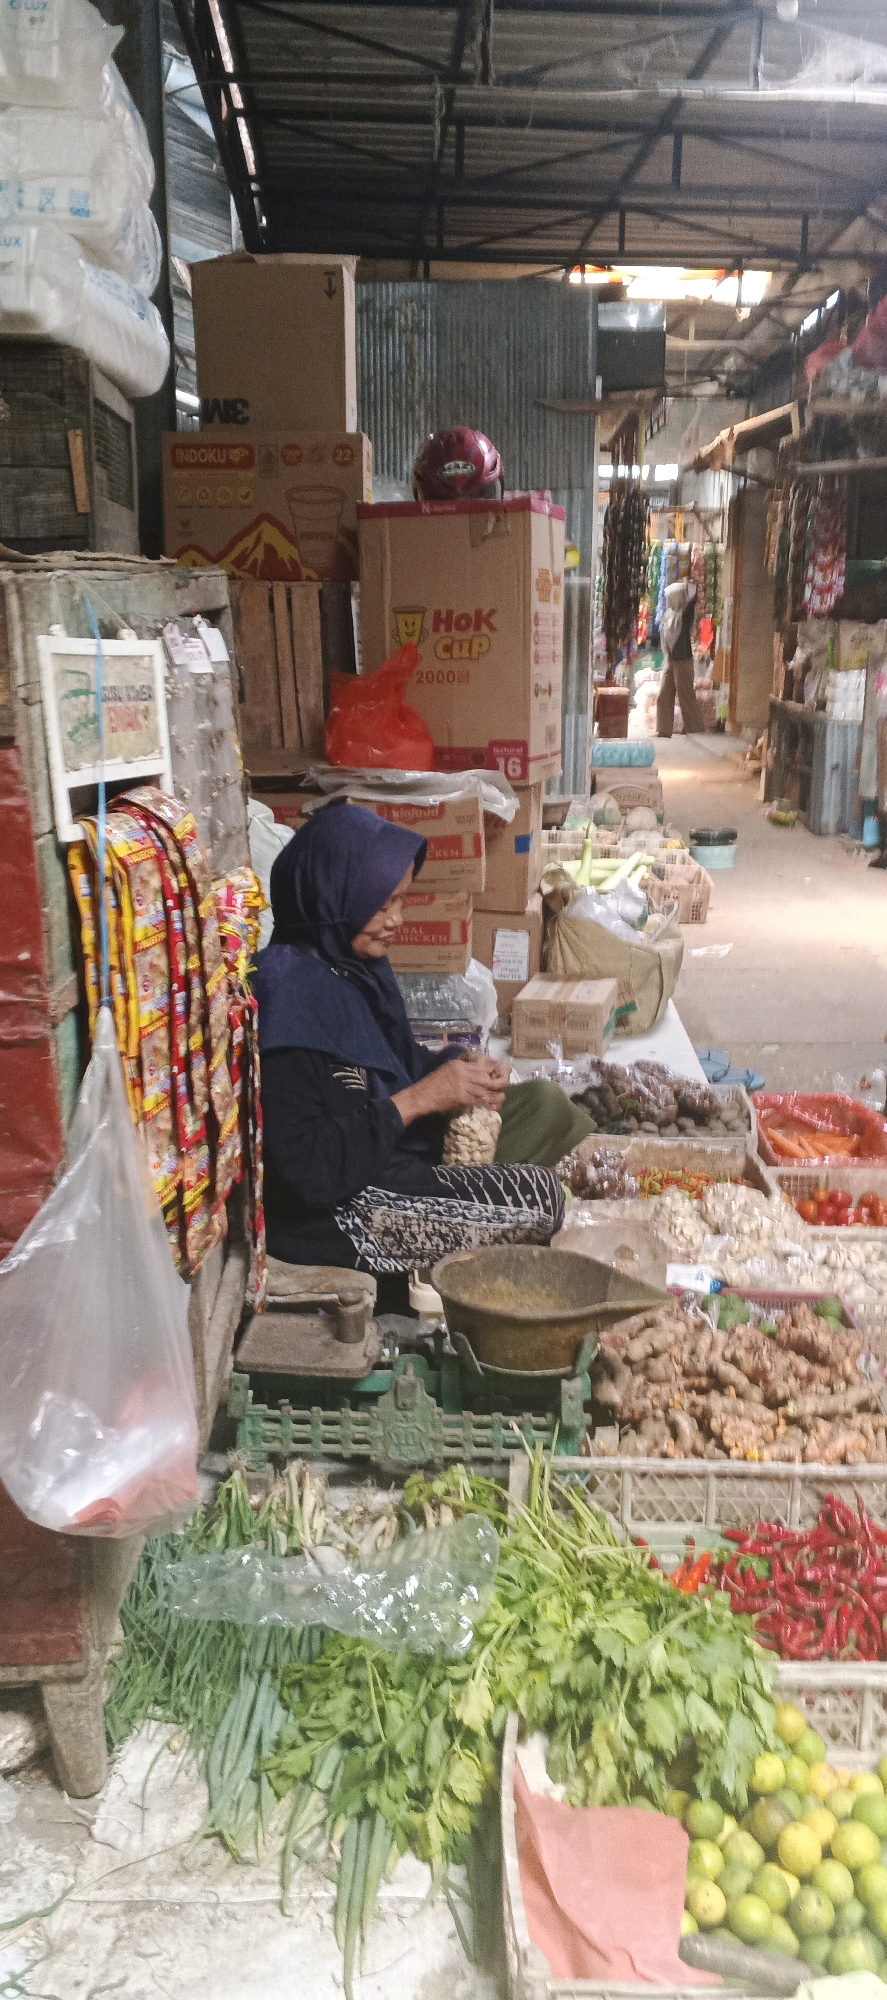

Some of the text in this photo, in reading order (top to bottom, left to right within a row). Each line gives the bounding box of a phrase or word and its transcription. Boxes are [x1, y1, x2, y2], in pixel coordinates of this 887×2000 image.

[202, 397, 250, 425] 3M
[175, 448, 227, 464] INDOKU
[432, 608, 498, 632] HoK
[415, 669, 456, 685] 2000
